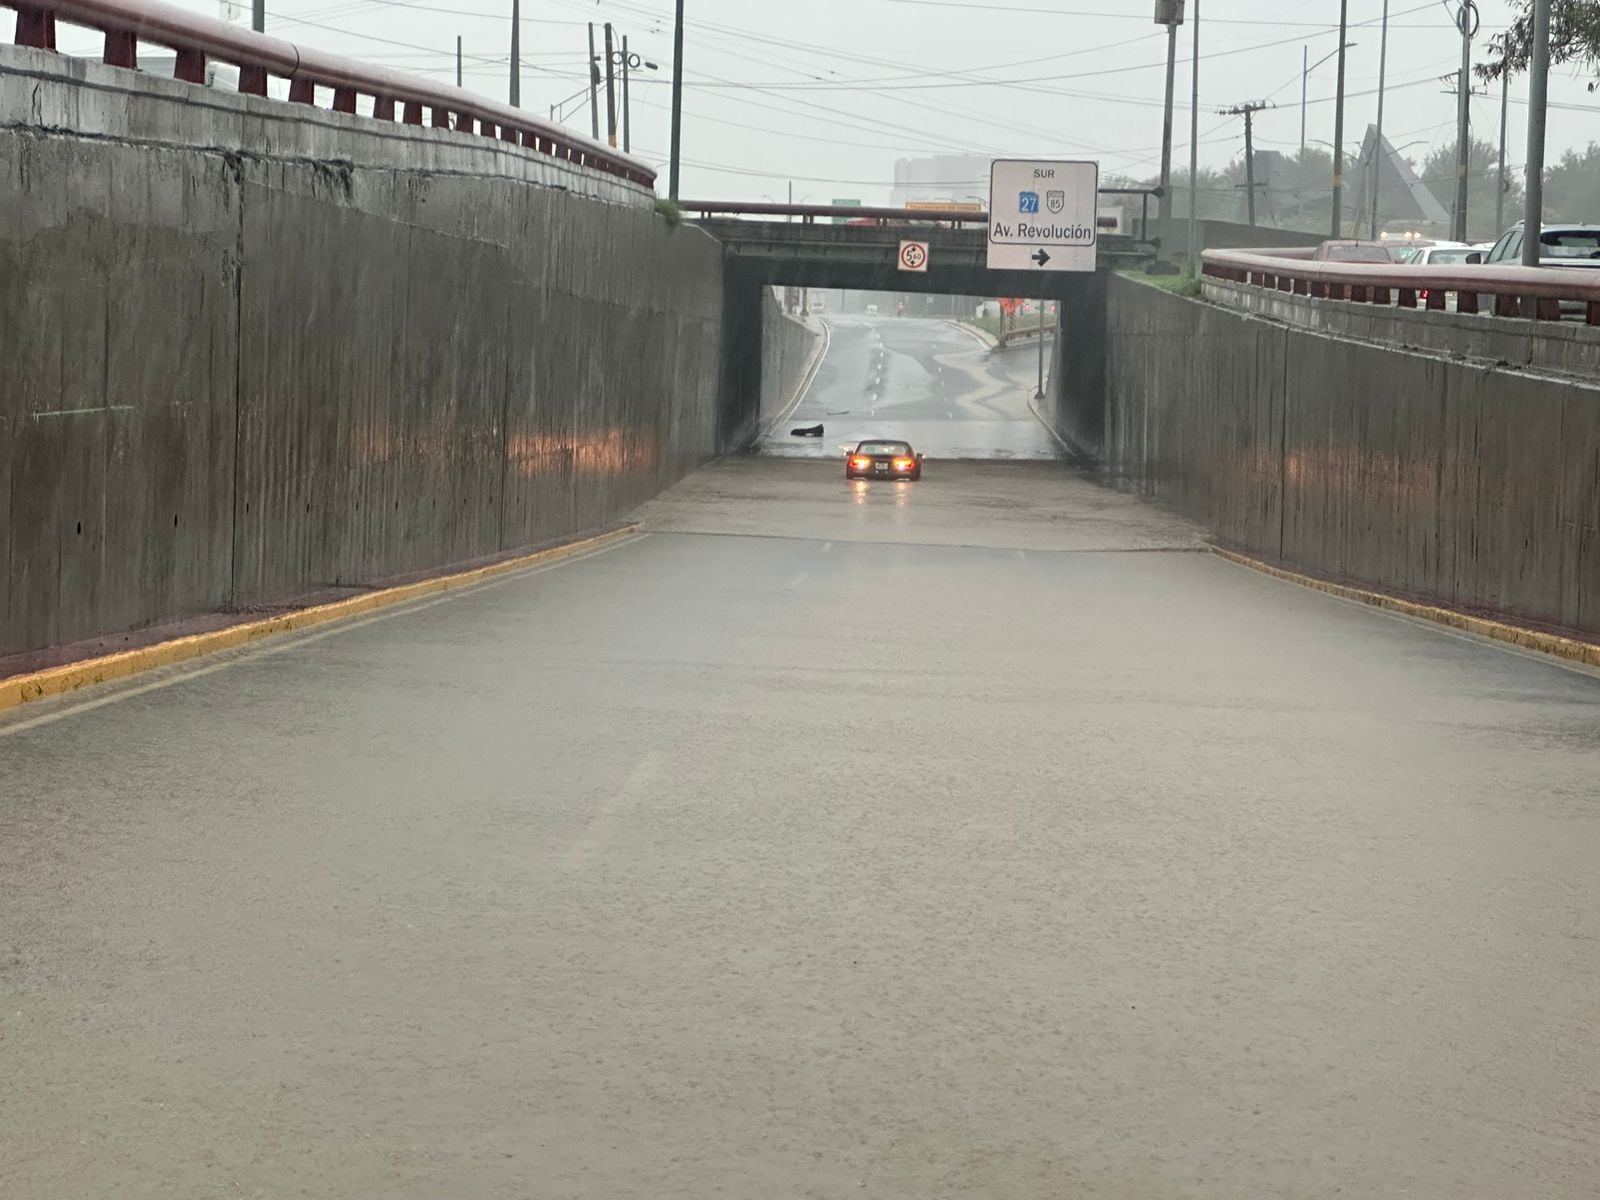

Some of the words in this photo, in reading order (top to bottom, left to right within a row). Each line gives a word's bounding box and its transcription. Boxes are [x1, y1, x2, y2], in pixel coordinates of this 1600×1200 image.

[1033, 169, 1055, 178] SUR
[1021, 197, 1037, 212] 27
[1050, 199, 1061, 209] 85
[993, 222, 1013, 237] Av.
[1018, 223, 1091, 239] Revolución
